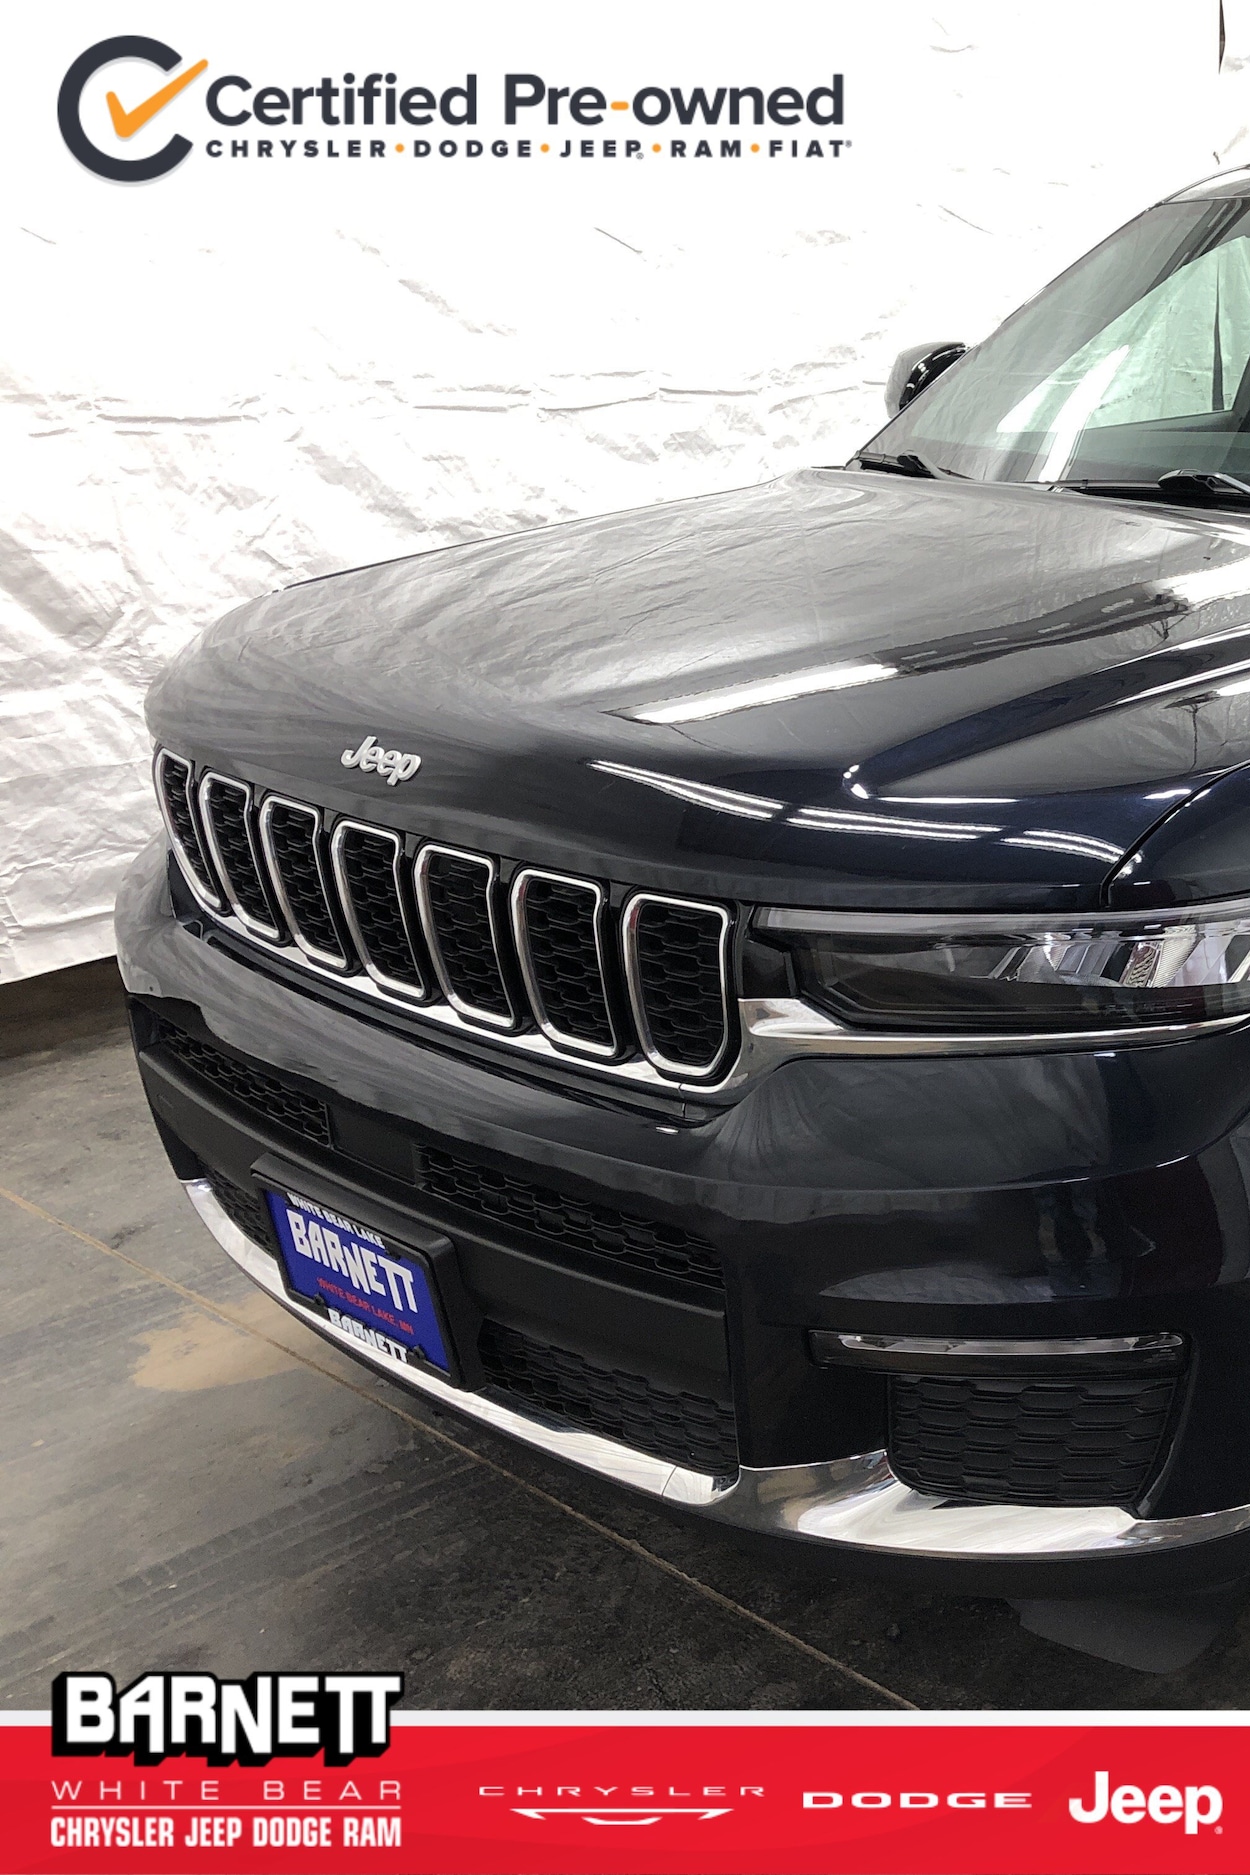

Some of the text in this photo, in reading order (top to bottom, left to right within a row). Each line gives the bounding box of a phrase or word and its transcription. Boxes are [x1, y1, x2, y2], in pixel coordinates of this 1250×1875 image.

[341, 735, 421, 786] Jeep
[287, 1192, 386, 1250] WHITE BEAR LAKE
[286, 1208, 418, 1314] BARNETT
[328, 1308, 408, 1363] BARNETT
